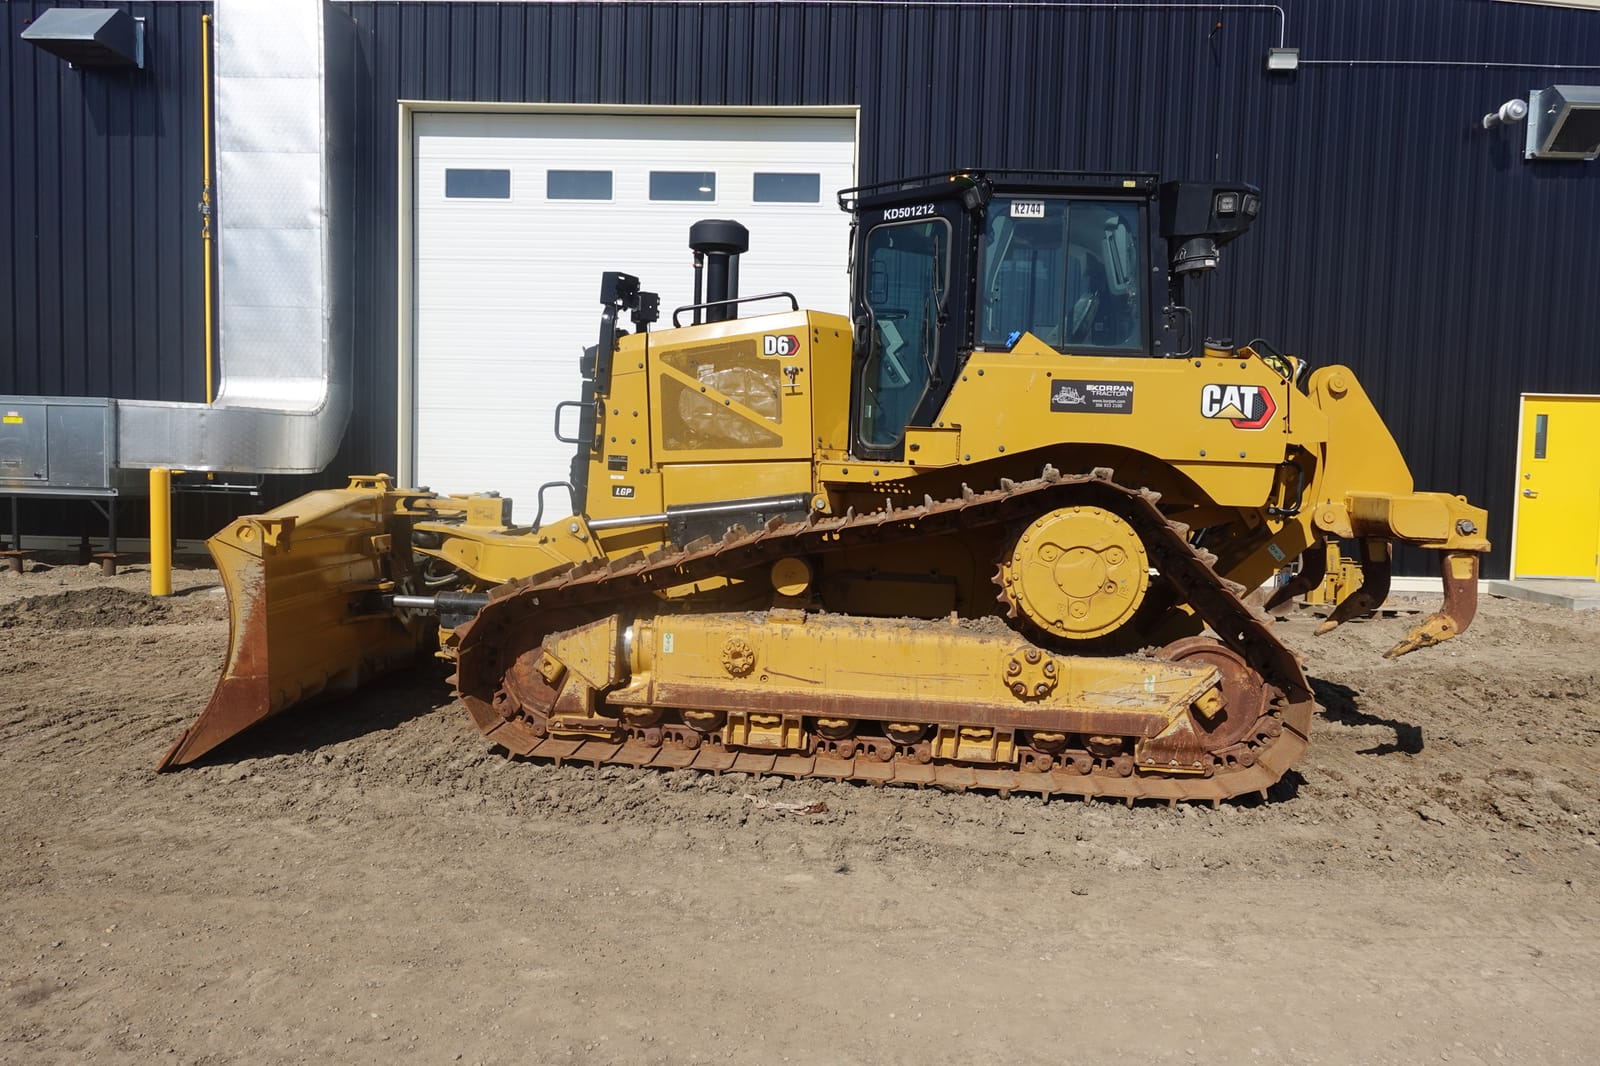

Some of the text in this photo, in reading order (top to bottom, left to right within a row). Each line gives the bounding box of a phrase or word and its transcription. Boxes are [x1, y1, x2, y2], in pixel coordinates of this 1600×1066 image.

[883, 203, 935, 220] KD501212
[1014, 202, 1041, 215] K2744
[763, 335, 789, 355] D6
[1087, 384, 1133, 392] KORPAN
[1202, 384, 1259, 419] CAT
[615, 487, 632, 496] LGP
